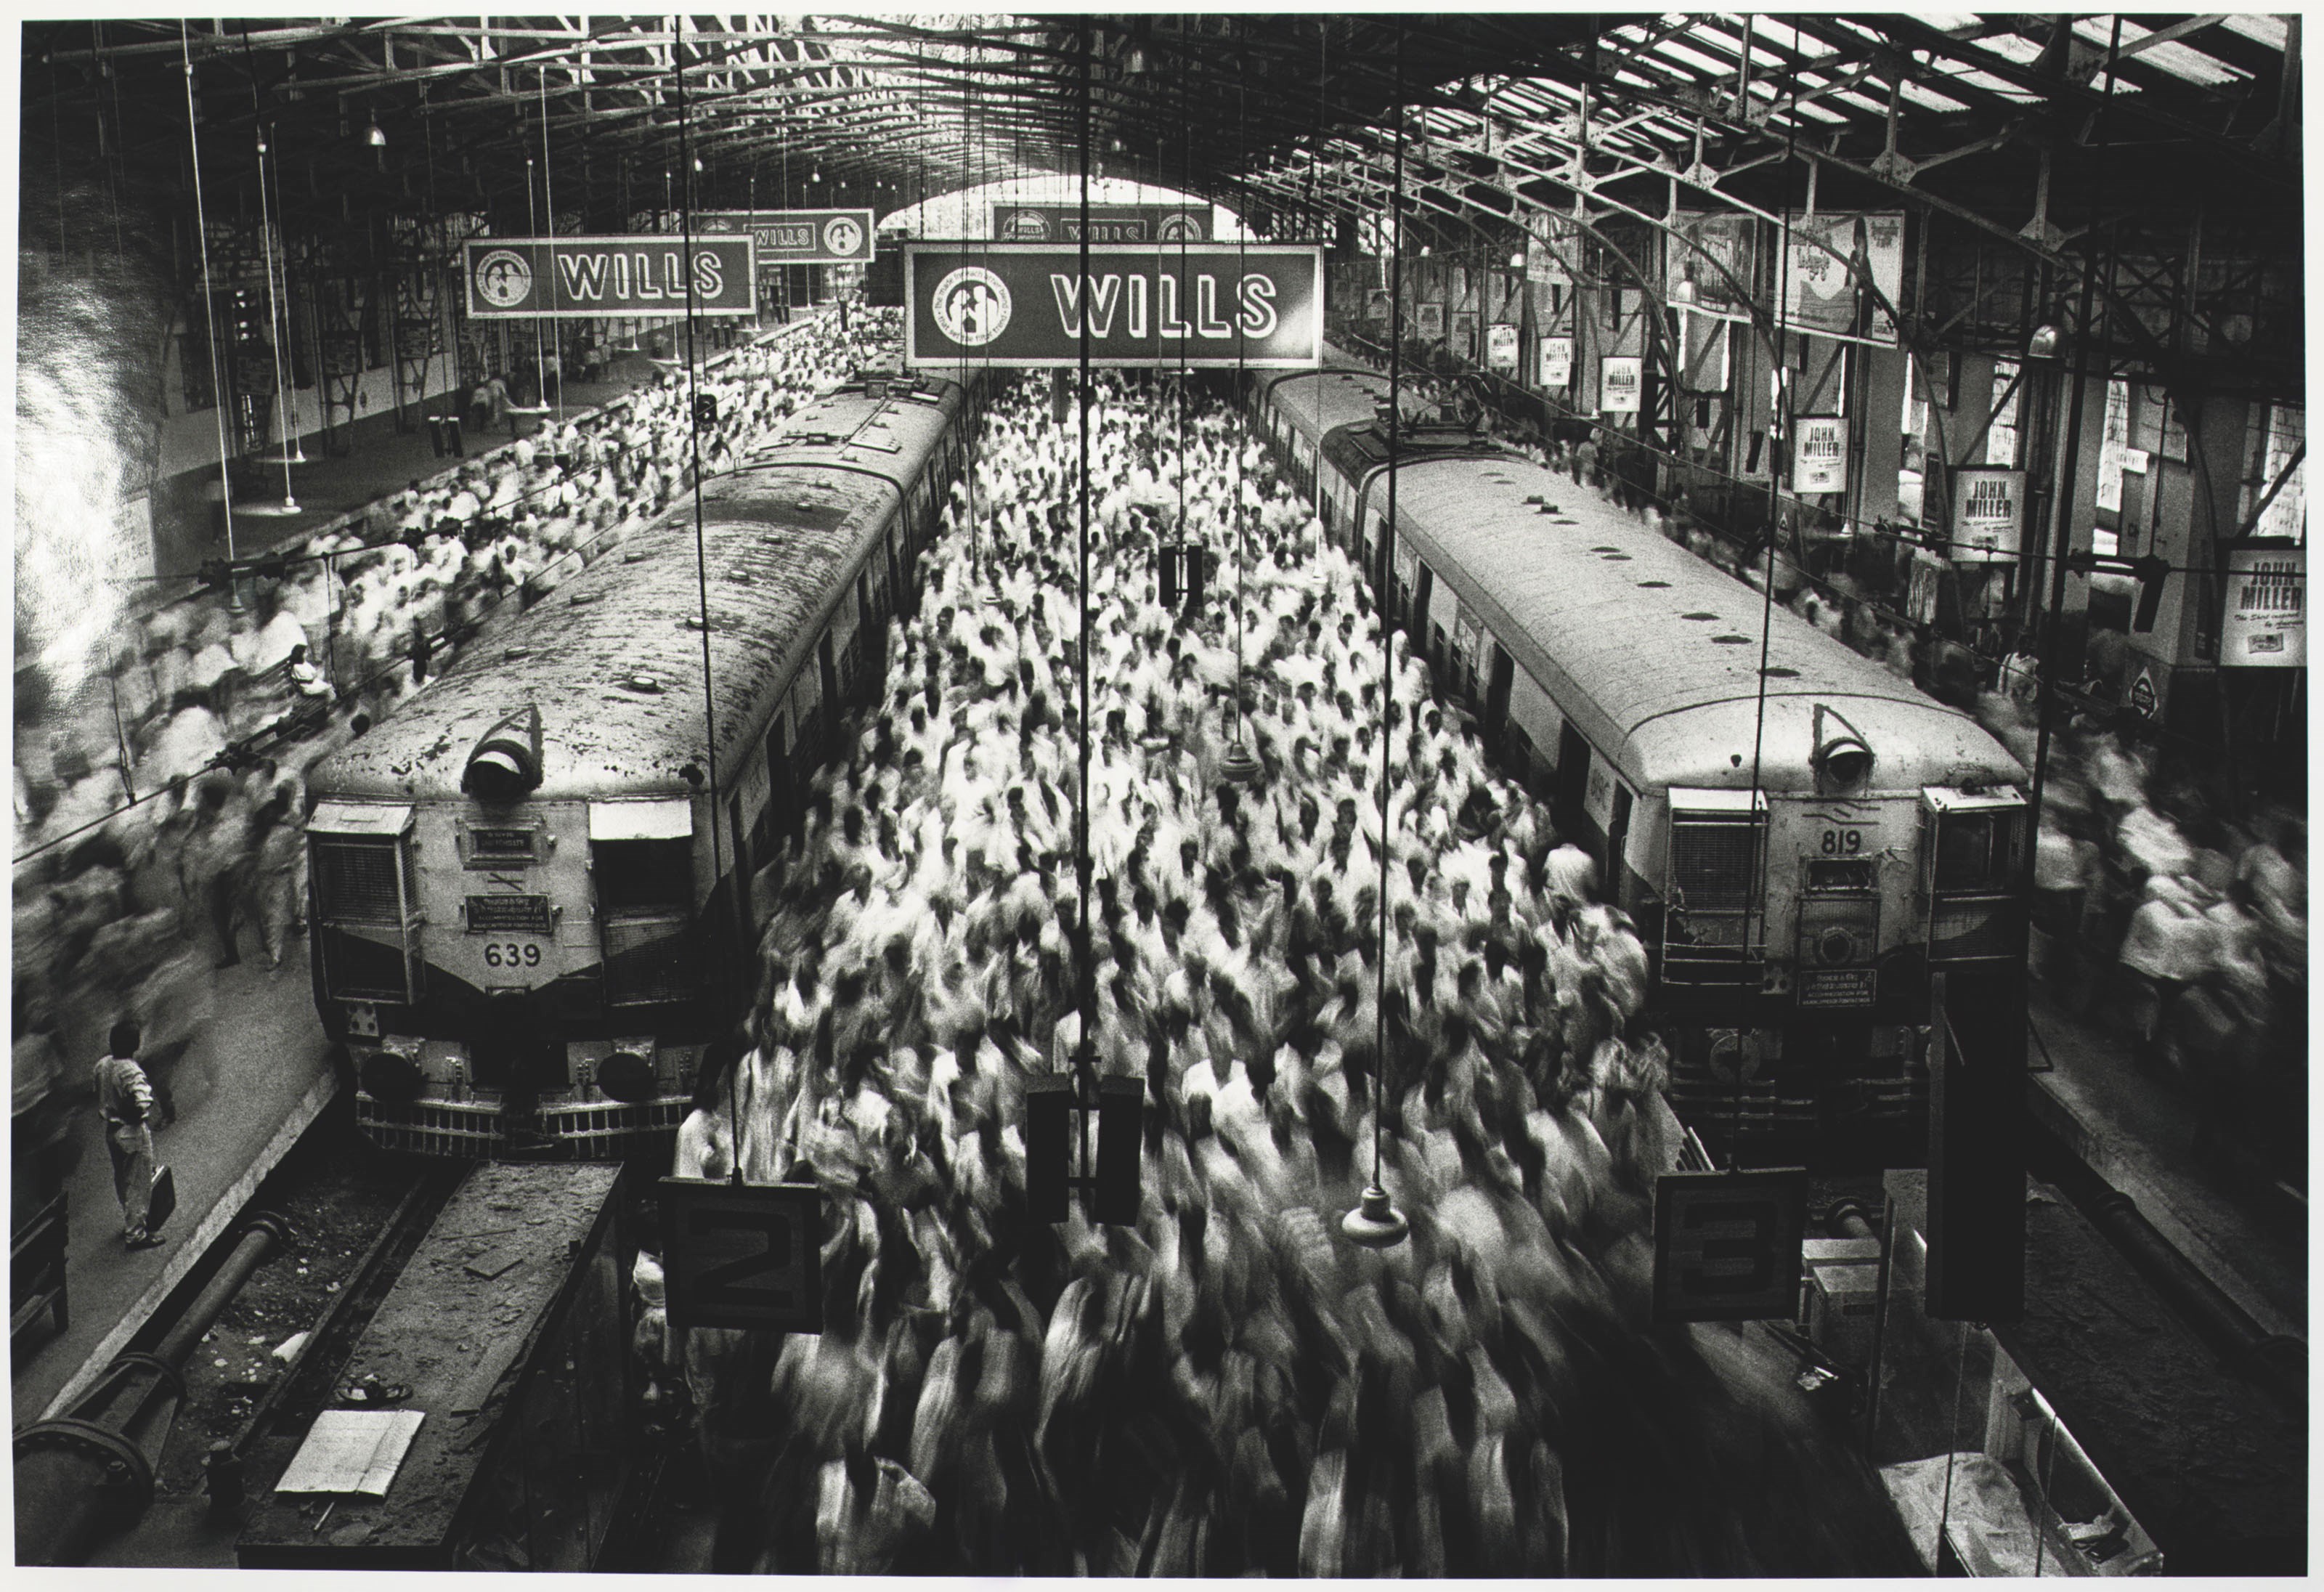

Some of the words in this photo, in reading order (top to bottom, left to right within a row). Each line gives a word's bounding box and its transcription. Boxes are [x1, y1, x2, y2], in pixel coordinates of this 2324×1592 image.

[757, 229, 809, 245] WILLS
[558, 251, 723, 301] WILLS
[1050, 274, 1277, 338] WILLS
[1609, 375, 1636, 386] MILLER
[1809, 426, 1835, 442] JOHN
[1804, 442, 1840, 457] MILLER
[1972, 481, 2007, 500] JOHN
[1965, 499, 2012, 518] MILLER
[2251, 562, 2296, 586] JOHN
[2240, 586, 2302, 610] MILLER
[1821, 829, 1861, 855] 819
[484, 943, 541, 967] 639
[690, 1209, 796, 1308] 2
[1682, 1201, 1778, 1296] 3
